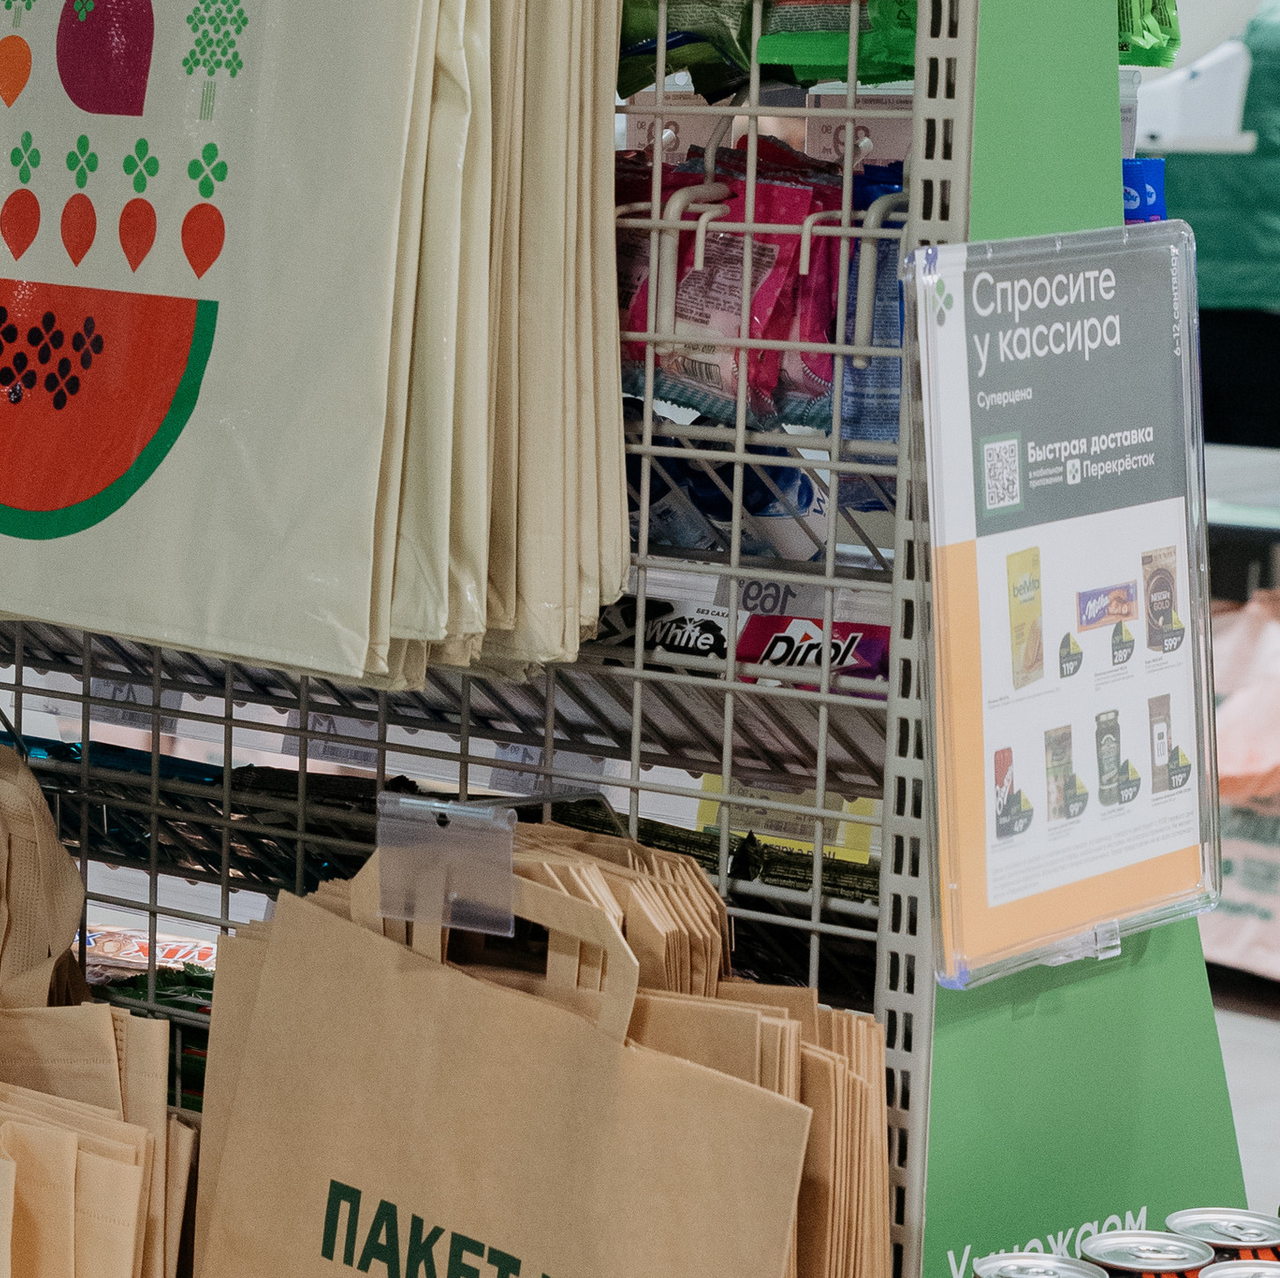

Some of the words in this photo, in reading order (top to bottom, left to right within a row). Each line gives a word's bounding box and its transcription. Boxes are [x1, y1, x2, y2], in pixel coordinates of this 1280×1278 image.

[972, 268, 1116, 322] Спросите
[973, 332, 990, 378] у
[998, 314, 1121, 361] кассира
[977, 386, 1033, 410] Суперцена
[1027, 436, 1088, 464] Быстрая
[1090, 425, 1154, 454] доставка
[1082, 451, 1155, 480] Перекрёсток
[645, 618, 714, 650] White
[758, 633, 862, 667] Dirol
